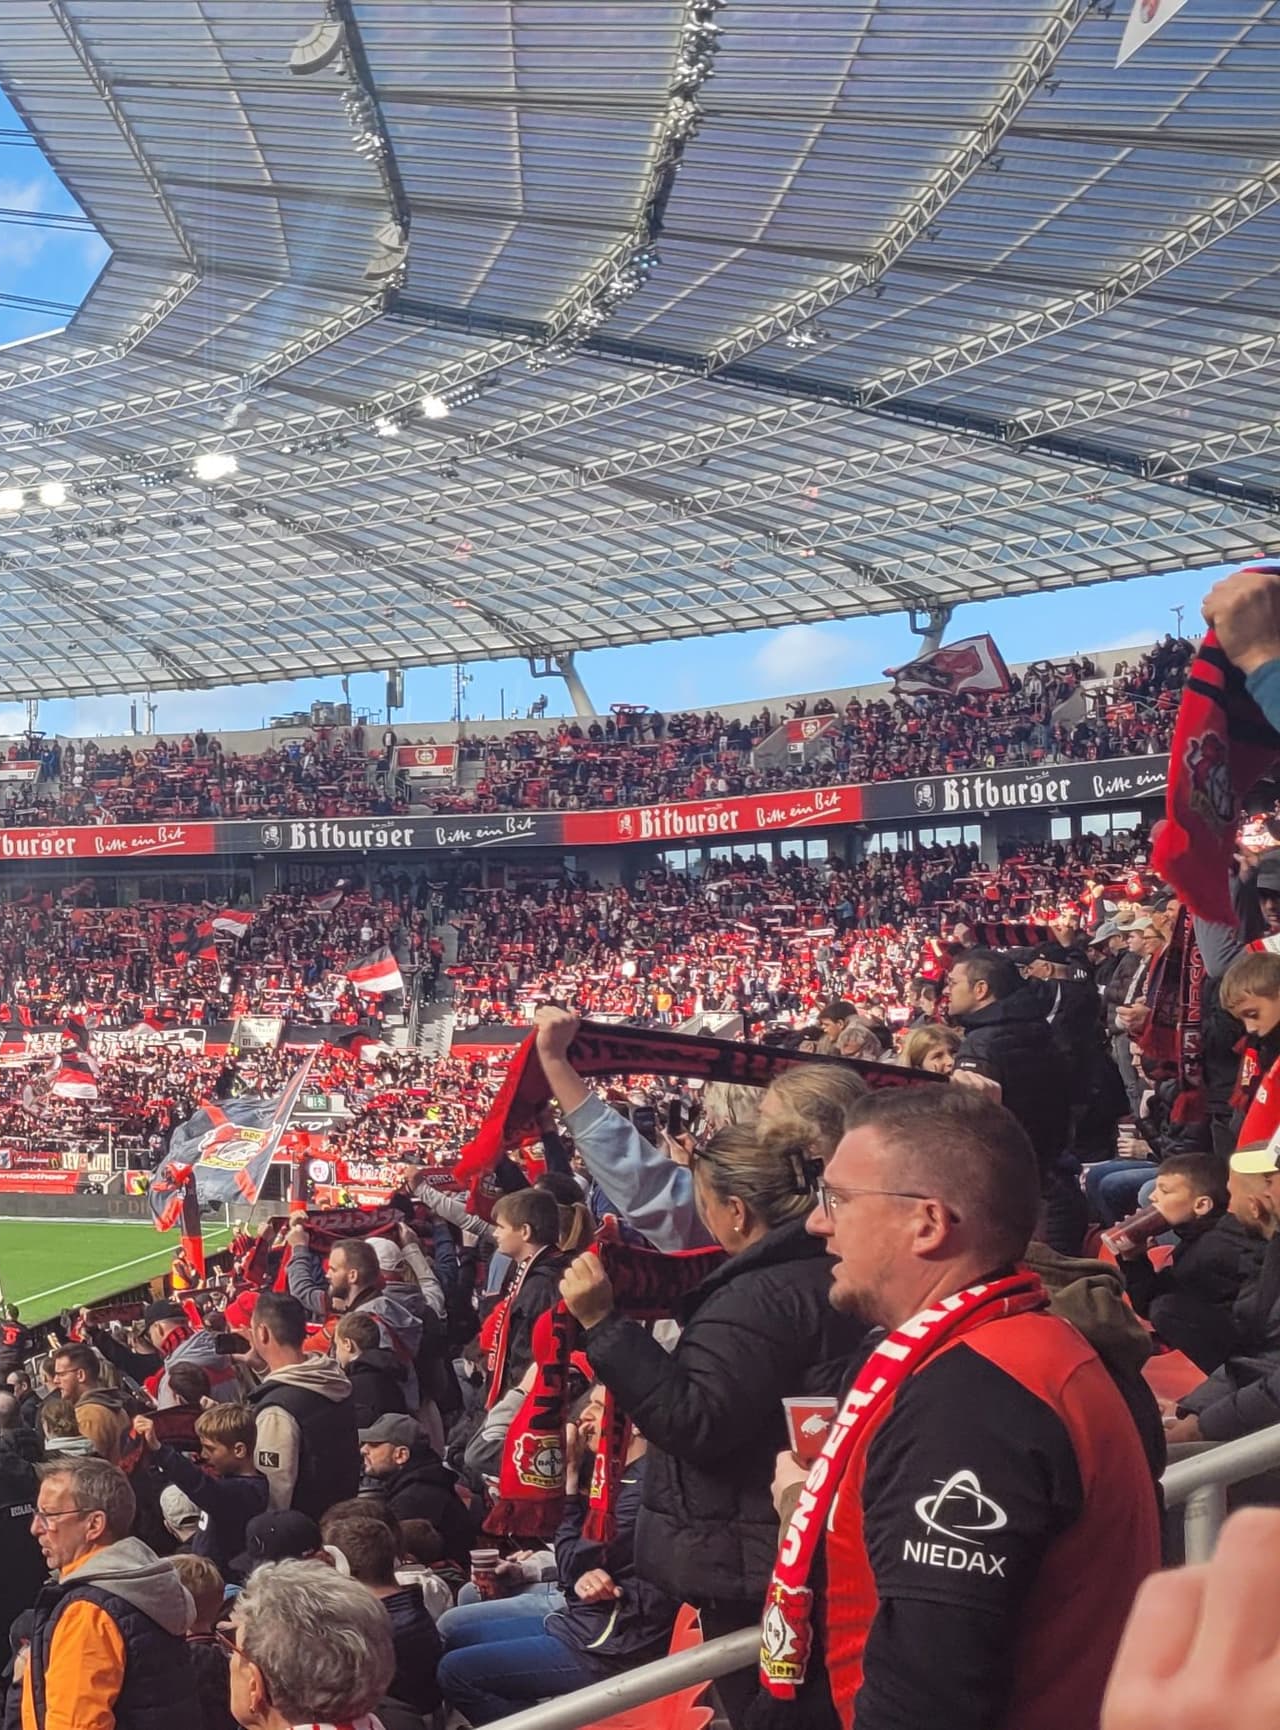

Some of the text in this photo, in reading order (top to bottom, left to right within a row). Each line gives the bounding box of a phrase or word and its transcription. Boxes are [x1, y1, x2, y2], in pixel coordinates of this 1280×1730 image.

[942, 776, 1072, 812] Bitburger
[1136, 771, 1167, 786] ein
[289, 822, 415, 850] Bitburger
[476, 826, 503, 838] ein
[506, 817, 536, 833] Bit
[639, 808, 740, 838] Bitburger
[789, 802, 814, 817] ein
[815, 792, 842, 810] Bit
[130, 835, 155, 848] ein
[158, 827, 186, 842] Bit
[903, 1538, 1007, 1579] NIEDAX
